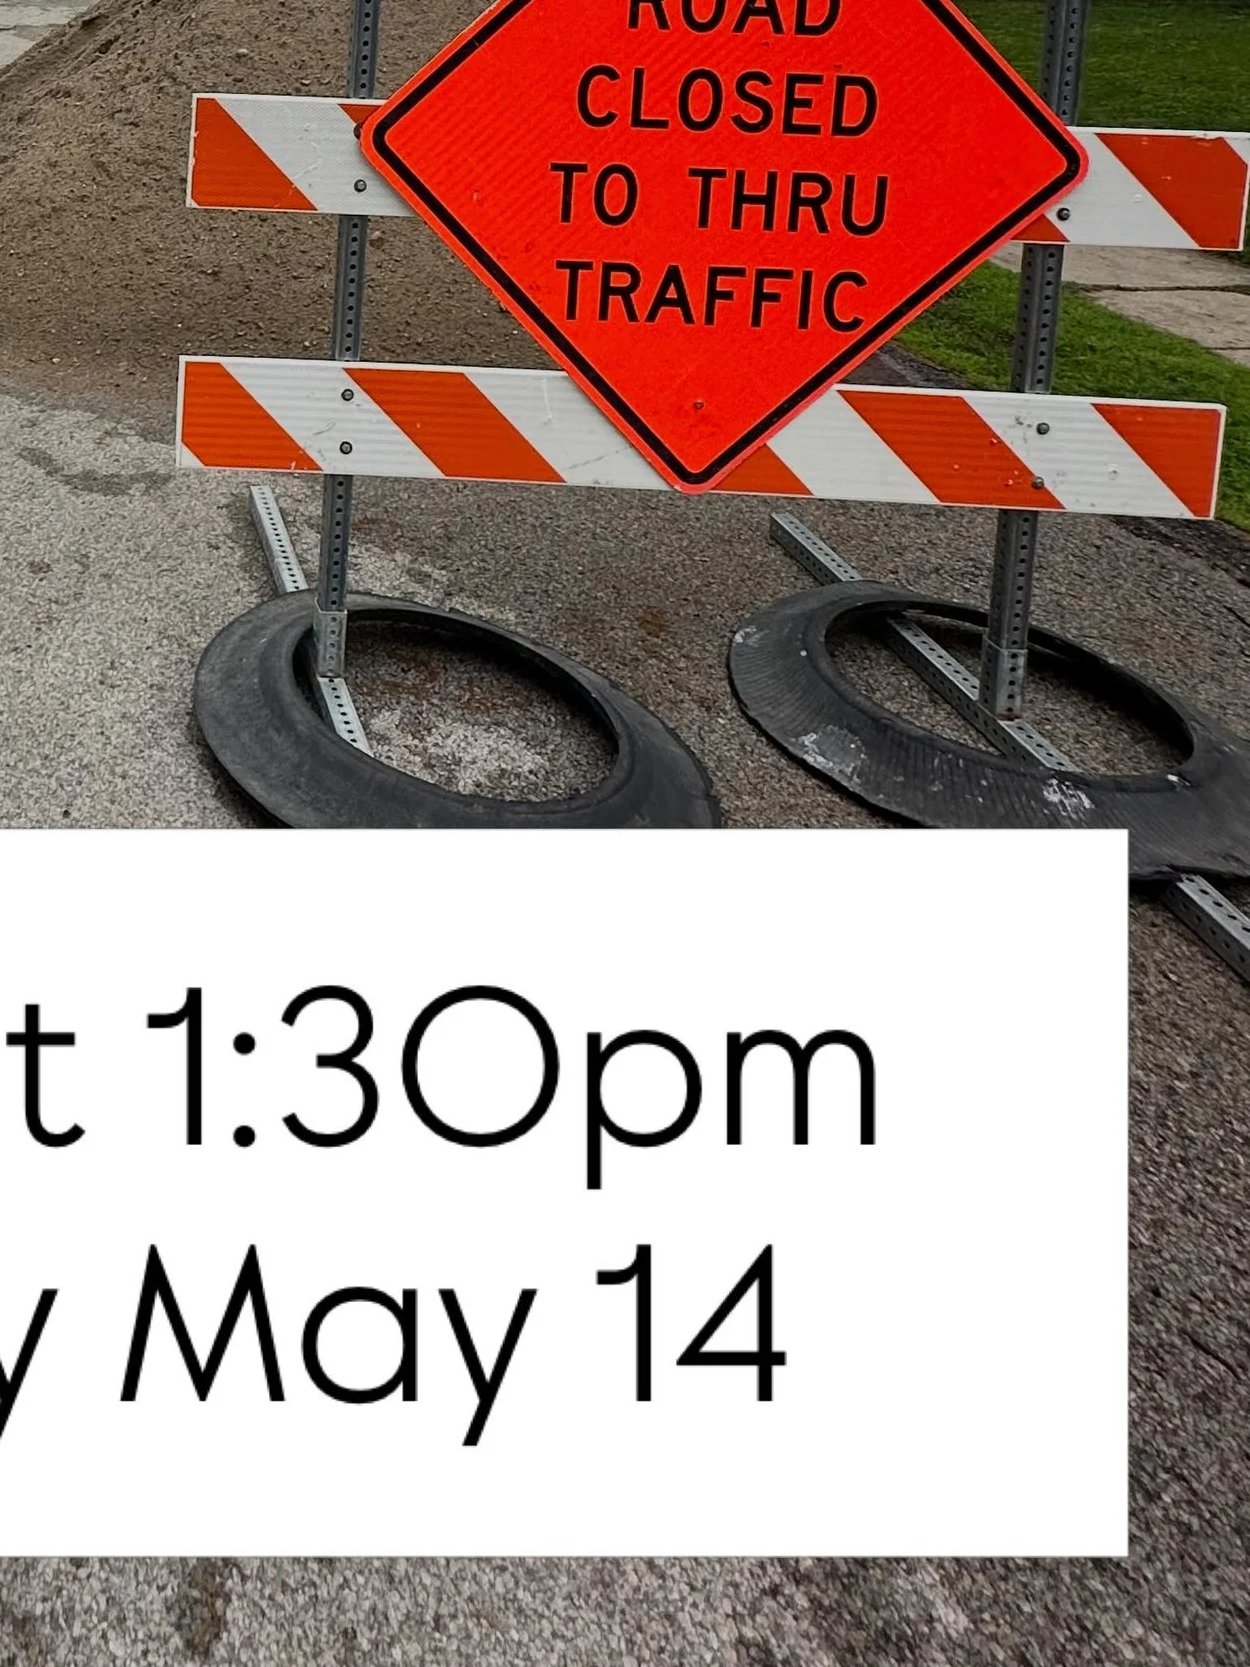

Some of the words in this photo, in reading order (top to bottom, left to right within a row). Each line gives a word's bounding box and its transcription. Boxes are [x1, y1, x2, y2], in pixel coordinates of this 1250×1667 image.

[577, 64, 878, 137] CLOSED
[550, 162, 638, 226] TO
[688, 167, 888, 237] THRU
[555, 260, 867, 333] TRAFFIC
